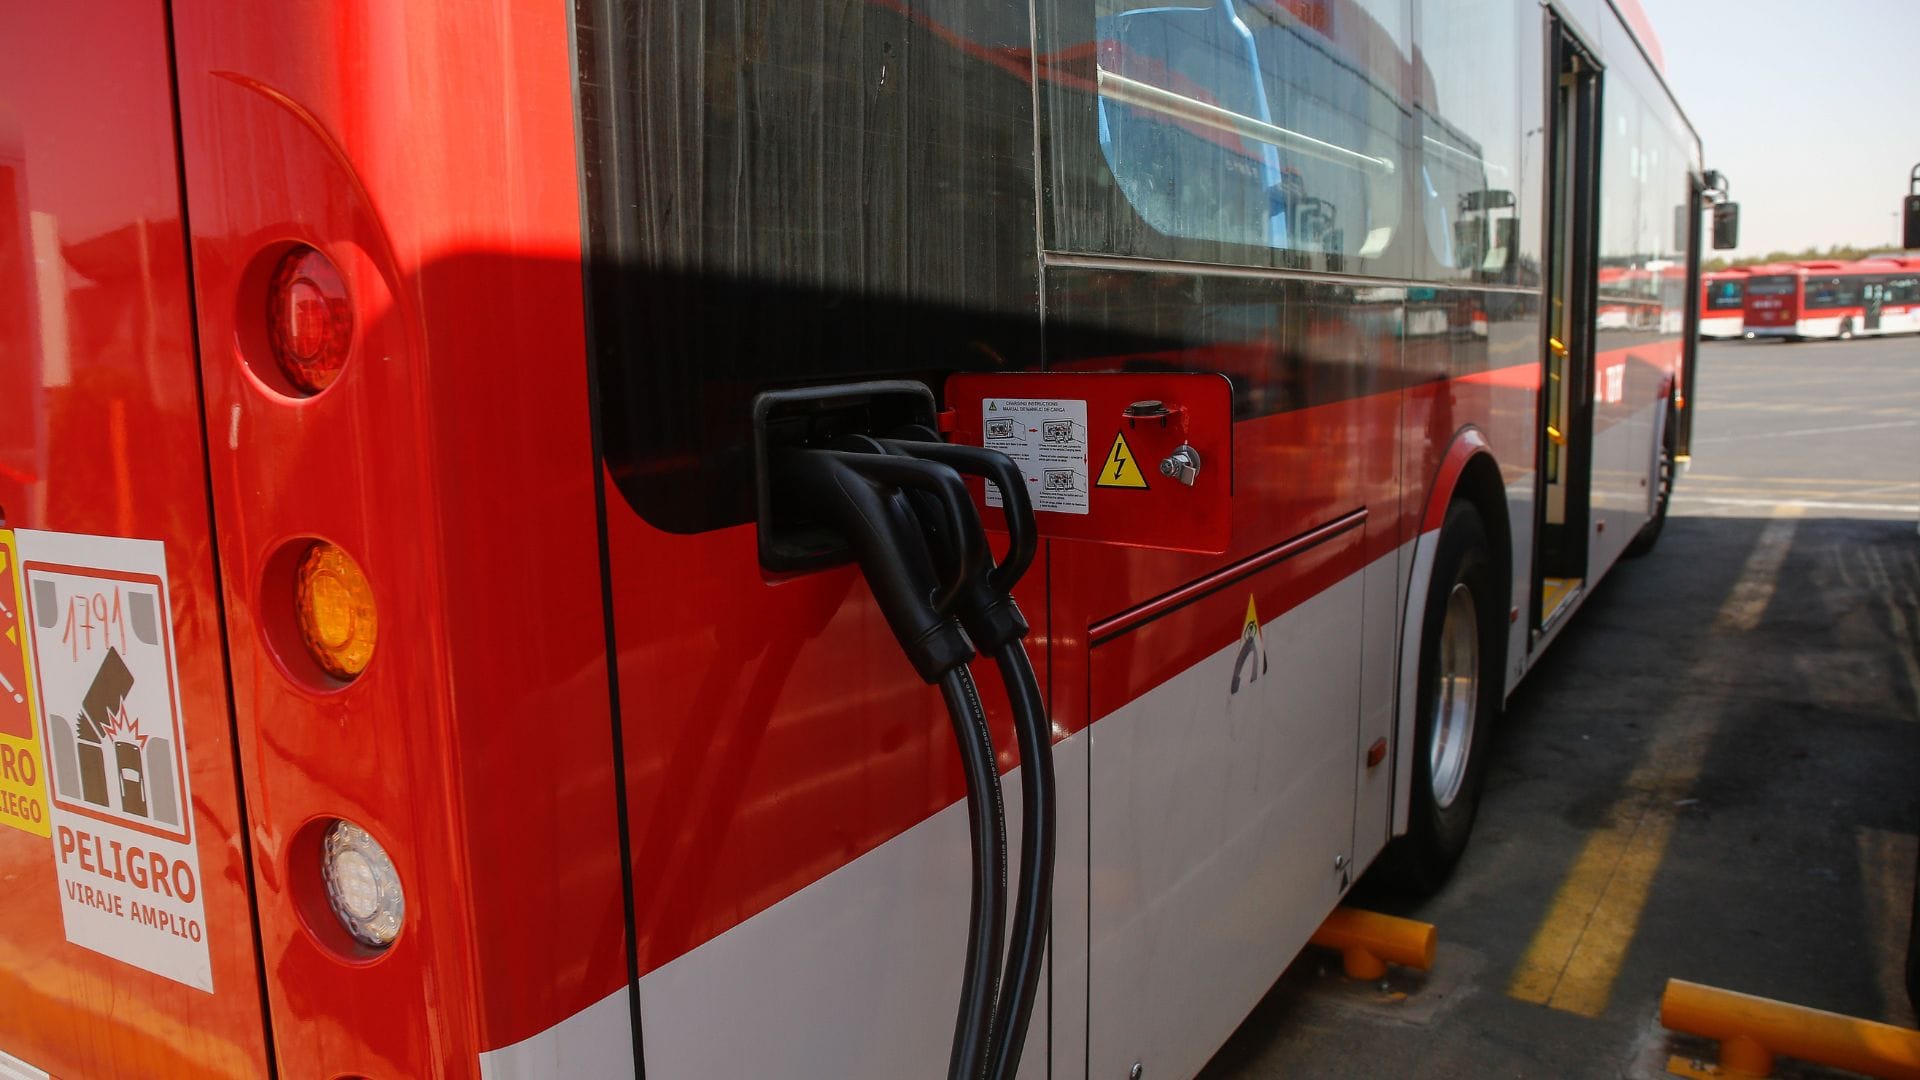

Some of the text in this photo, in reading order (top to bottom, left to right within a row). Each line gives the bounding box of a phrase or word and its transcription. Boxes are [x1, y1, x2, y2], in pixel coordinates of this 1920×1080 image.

[62, 584, 127, 663] 1791
[0, 743, 36, 787] RO
[0, 789, 42, 824] IEGO
[57, 825, 196, 904] PELIGRO
[65, 879, 201, 943] VIRAJE AMPLIO
